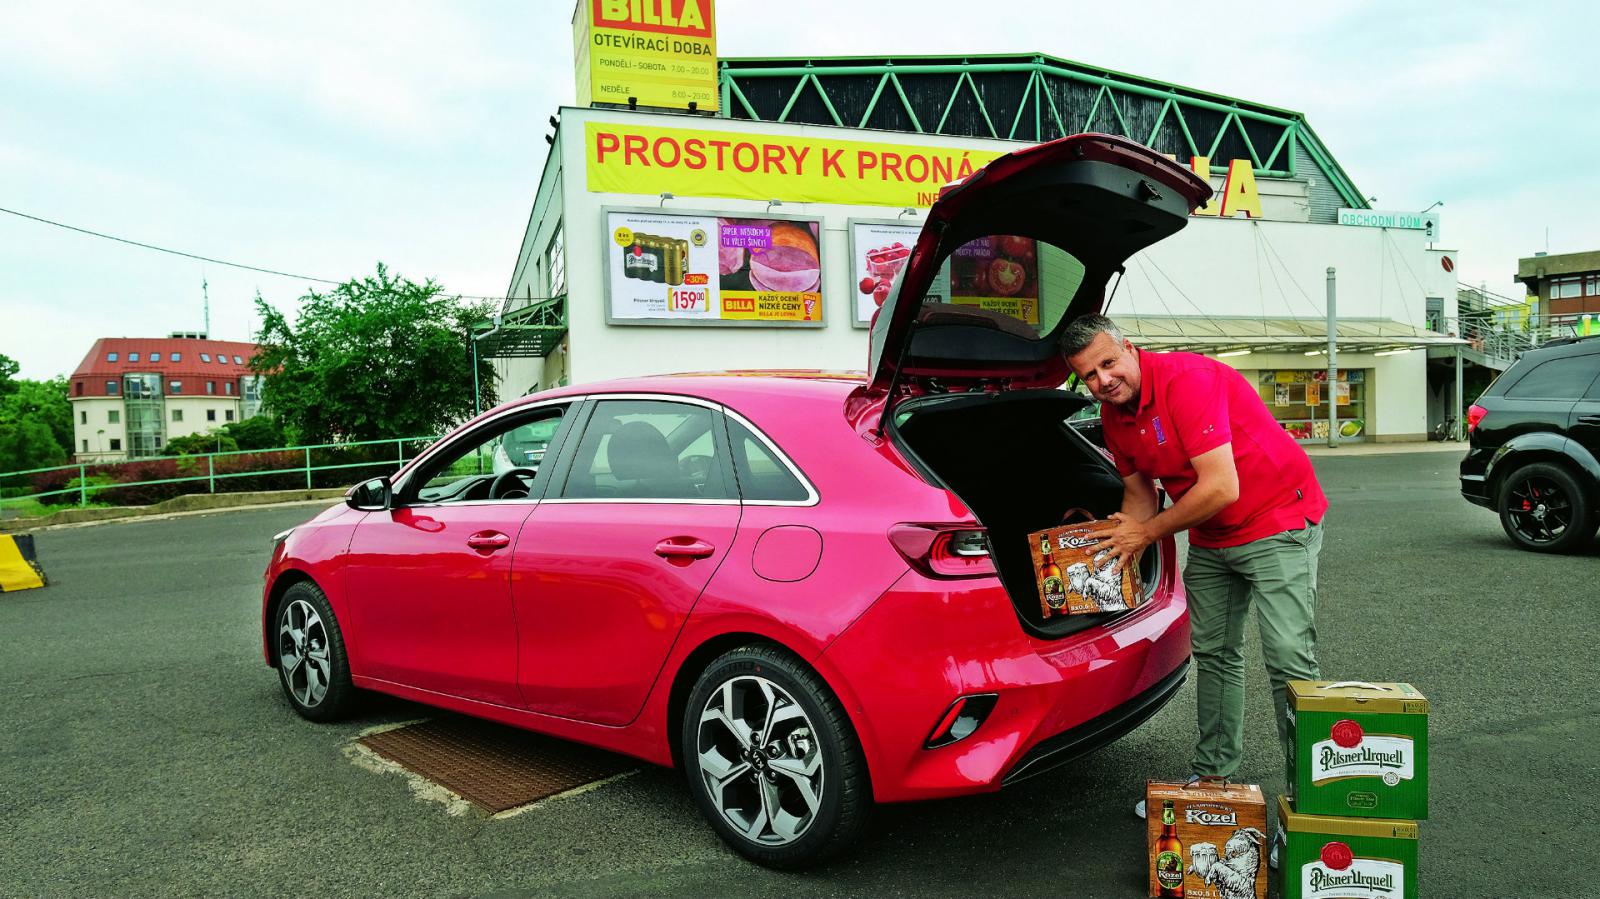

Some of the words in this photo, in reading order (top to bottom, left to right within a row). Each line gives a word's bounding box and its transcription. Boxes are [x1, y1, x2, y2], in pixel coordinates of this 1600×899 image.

[601, 0, 706, 30] BILLA
[594, 33, 669, 52] OTEVÍRACÍ
[673, 41, 712, 56] DOBA
[600, 58, 632, 69] PONDĚLÍ
[638, 62, 666, 71] SOBOTA
[600, 84, 630, 95] NEDĚLE
[596, 132, 810, 176] PROSTORY
[823, 149, 846, 178] K
[857, 151, 992, 184] PRONÁ
[1341, 213, 1396, 227] OBCHODNÍ
[1399, 214, 1421, 228] DŮM
[686, 275, 707, 284] -30%
[725, 299, 754, 310] BILLA
[782, 303, 801, 311] CENY
[1185, 809, 1238, 826] Kozel
[1158, 871, 1182, 880] Kozel
